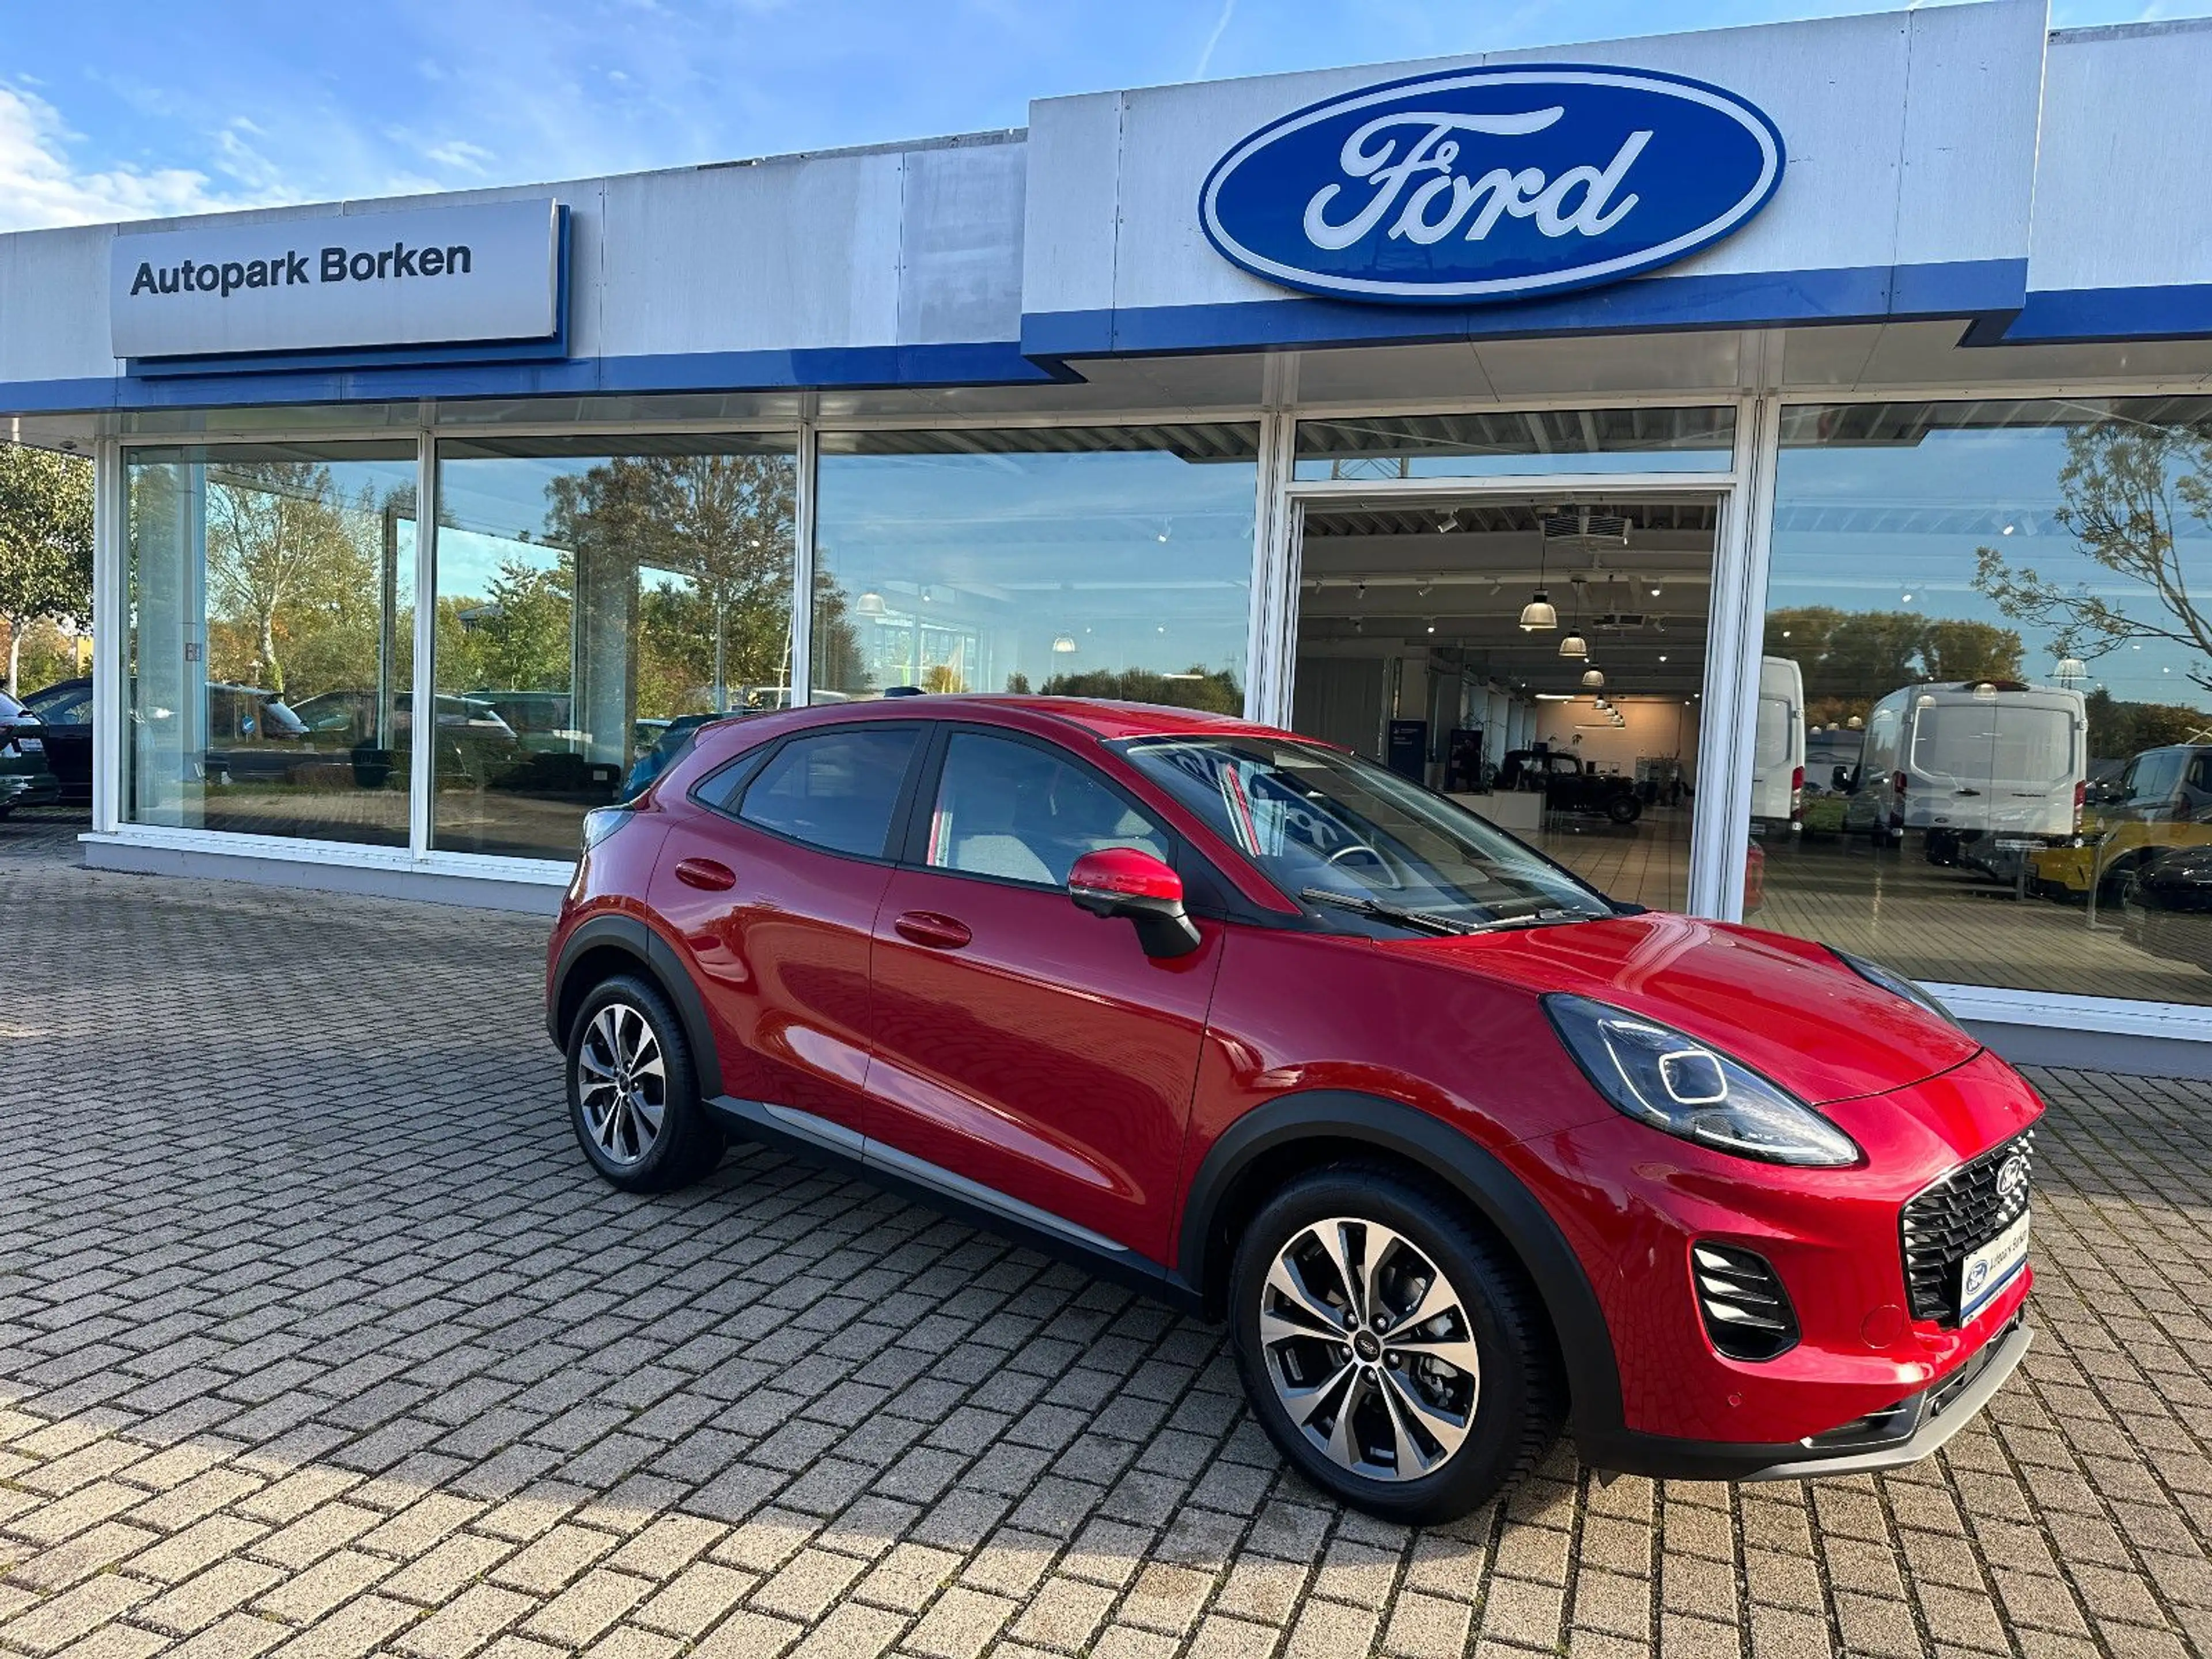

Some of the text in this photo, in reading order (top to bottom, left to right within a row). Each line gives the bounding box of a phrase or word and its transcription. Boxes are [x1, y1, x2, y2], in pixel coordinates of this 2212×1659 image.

[1304, 106, 1653, 249] Ford
[130, 241, 471, 298] Autopark Borken
